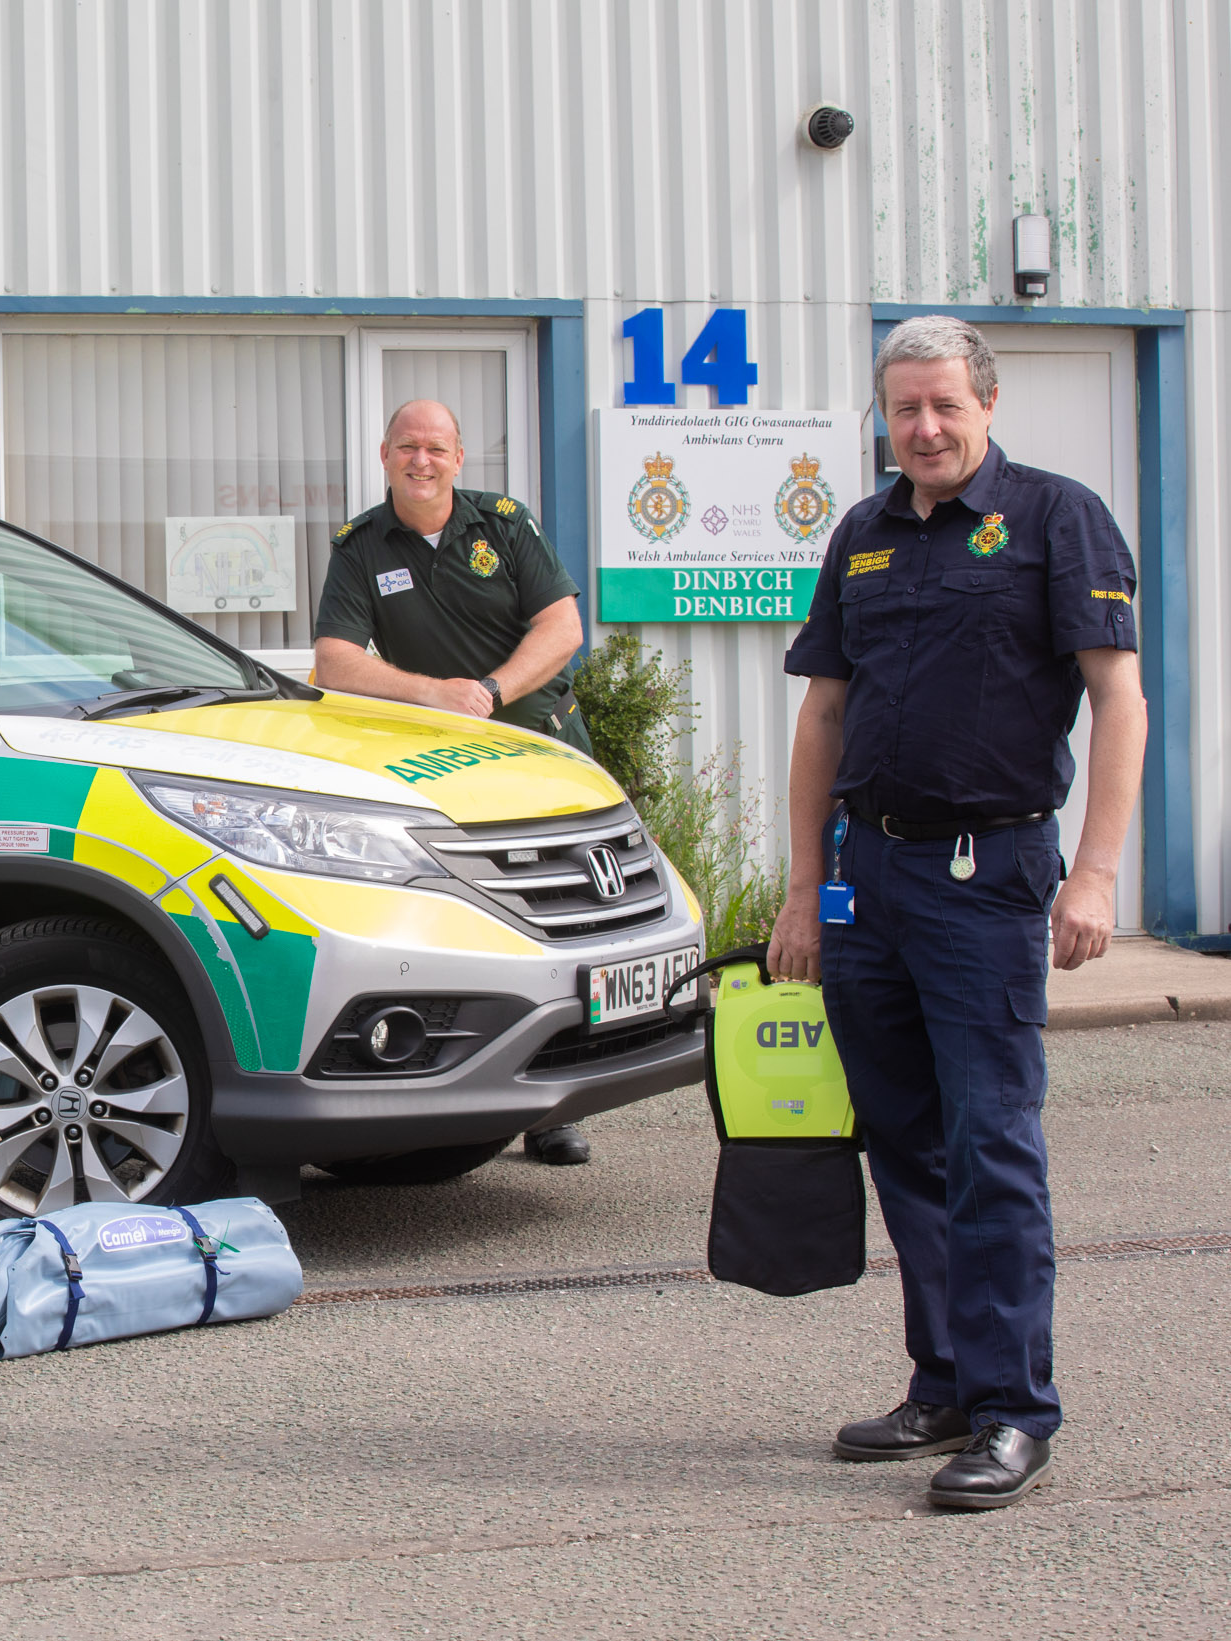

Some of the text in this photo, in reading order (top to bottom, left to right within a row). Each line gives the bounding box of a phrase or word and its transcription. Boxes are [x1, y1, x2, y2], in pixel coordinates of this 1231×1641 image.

[622, 308, 758, 405] 14
[630, 415, 833, 429] Ymddiriedolaeth GIG Gwasanaethau
[682, 434, 784, 449] Ambiwlans Cymru
[732, 504, 761, 516] NHS
[732, 518, 762, 527] CYMRU
[732, 529, 762, 537] WALES
[627, 550, 660, 562] Welsh
[663, 550, 727, 562] Ambulance
[730, 551, 775, 563] Services
[778, 551, 805, 562] NHS
[850, 555, 890, 570] DENBIGH
[672, 570, 794, 591] DINBYCH
[1091, 590, 1108, 599] FIRST
[673, 596, 794, 617] DENBIGH
[605, 961, 656, 1011] WN63
[756, 1020, 825, 1049] AED
[102, 1224, 147, 1247] Camel
